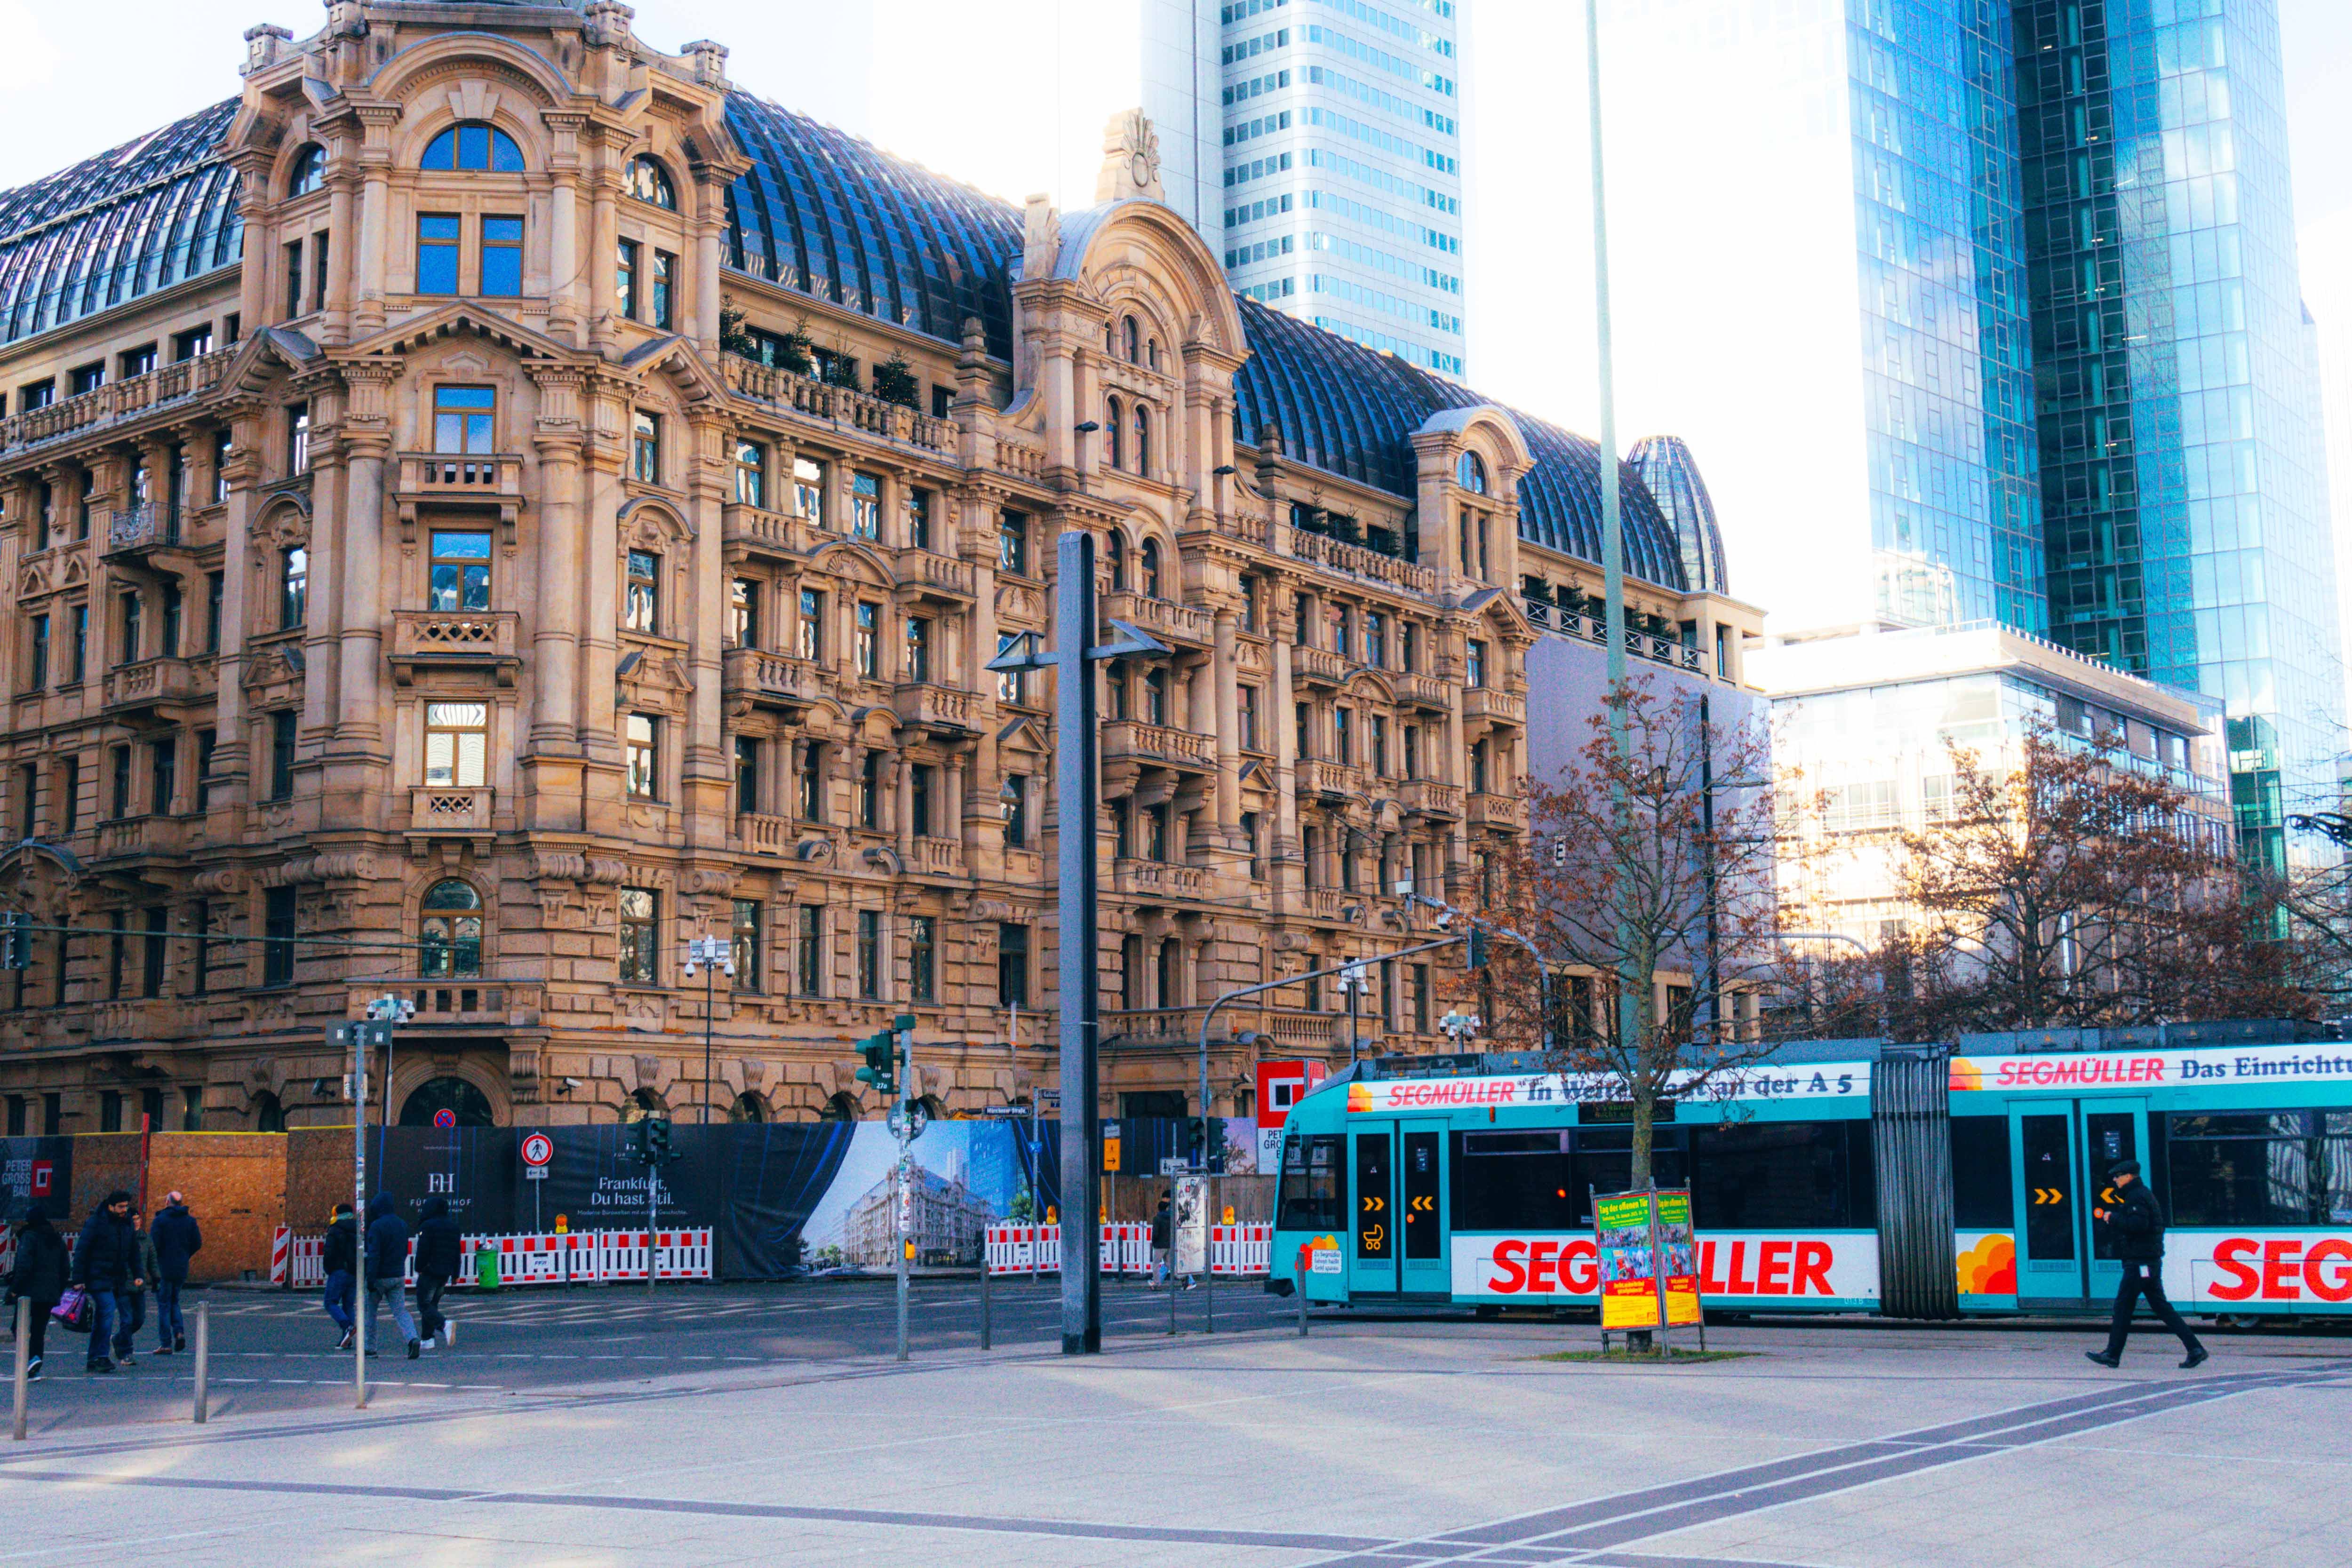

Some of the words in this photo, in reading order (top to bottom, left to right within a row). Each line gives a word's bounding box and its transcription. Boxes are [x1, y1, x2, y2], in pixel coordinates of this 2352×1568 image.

[1556, 841, 1564, 860] E
[1996, 1057, 2164, 1086] SEGMÜLLER
[2180, 1059, 2226, 1079] Das
[1388, 1080, 1515, 1106] SEGMÜLLER
[1527, 1082, 1552, 1101] In
[1754, 1074, 1800, 1094] der
[1806, 1072, 1828, 1092] A
[1837, 1074, 1853, 1094] 5
[1268, 1130, 1283, 1138] PET
[1264, 1140, 1282, 1149] GRO
[6, 1159, 32, 1171] PETER
[2, 1172, 31, 1184] GROSS
[13, 1185, 30, 1197] BAU
[591, 1192, 610, 1205] Du
[615, 1192, 645, 1205] hast
[648, 1192, 674, 1205] til.
[1599, 1205, 1609, 1215] Tag
[1618, 1201, 1639, 1211] offenen
[1639, 1198, 1648, 1208] Tür
[1488, 1240, 1836, 1295] SEGLLER
